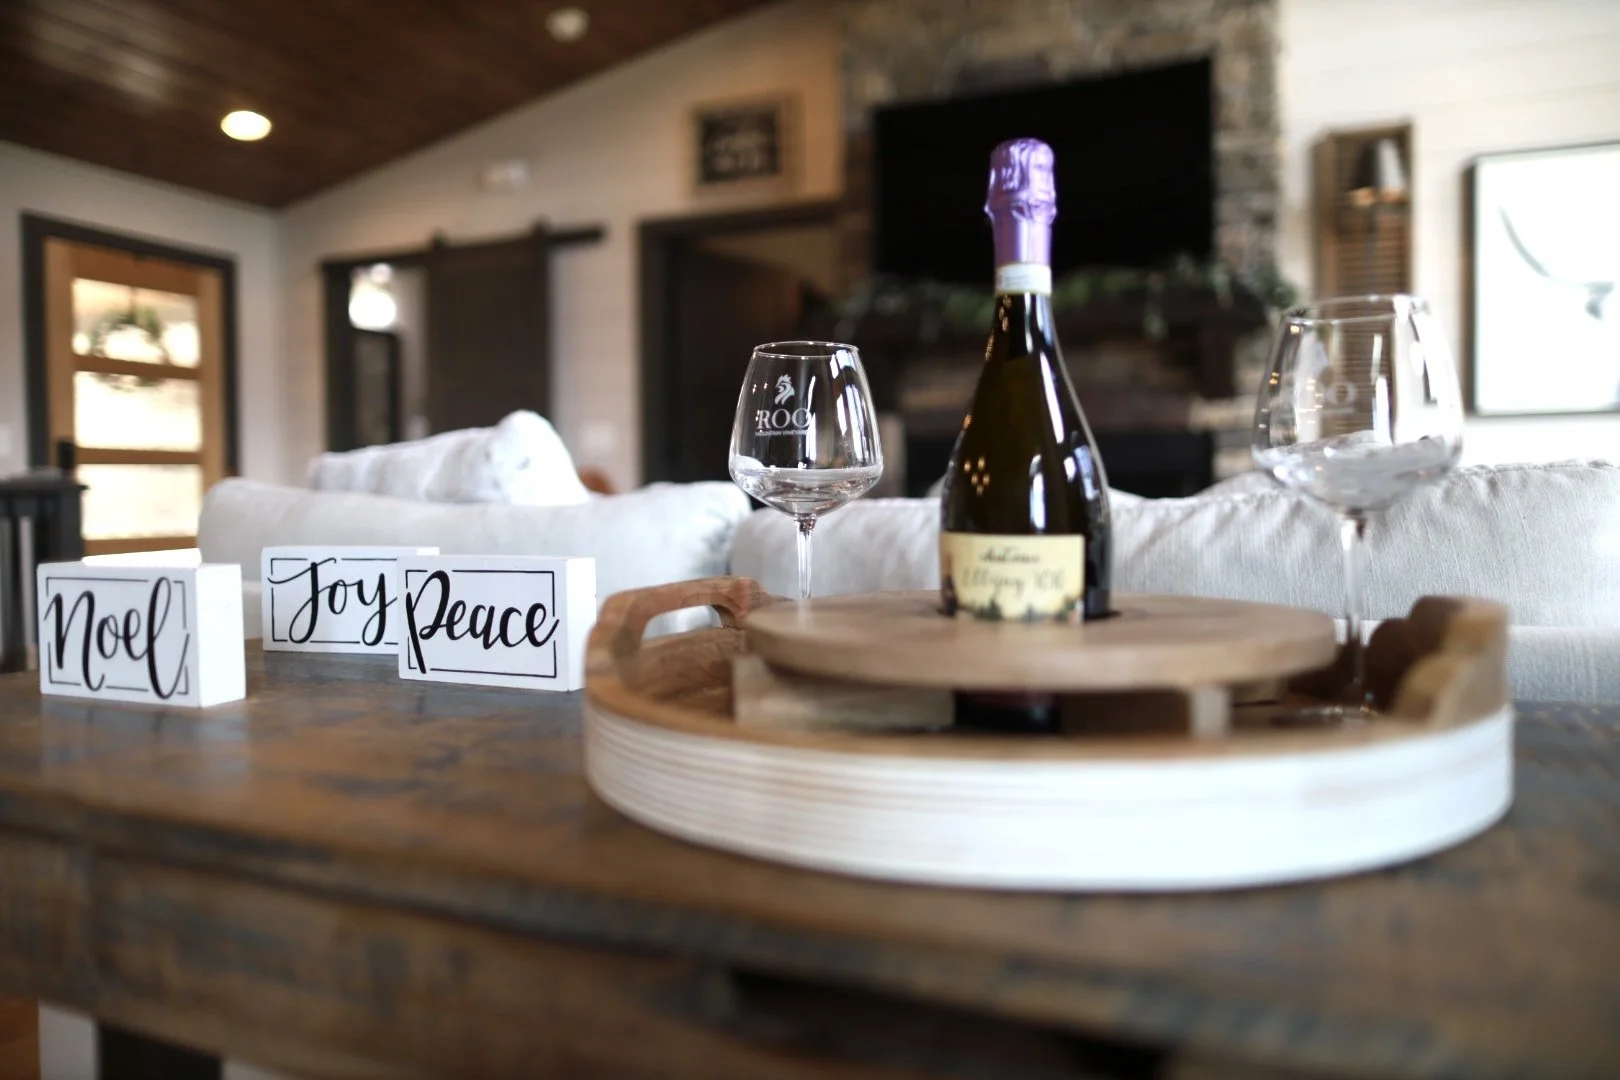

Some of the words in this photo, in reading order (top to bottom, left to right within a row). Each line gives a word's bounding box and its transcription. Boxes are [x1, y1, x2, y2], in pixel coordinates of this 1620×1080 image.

[44, 577, 190, 699] Noel
[267, 557, 398, 646] Joy
[405, 570, 560, 674] Peace
